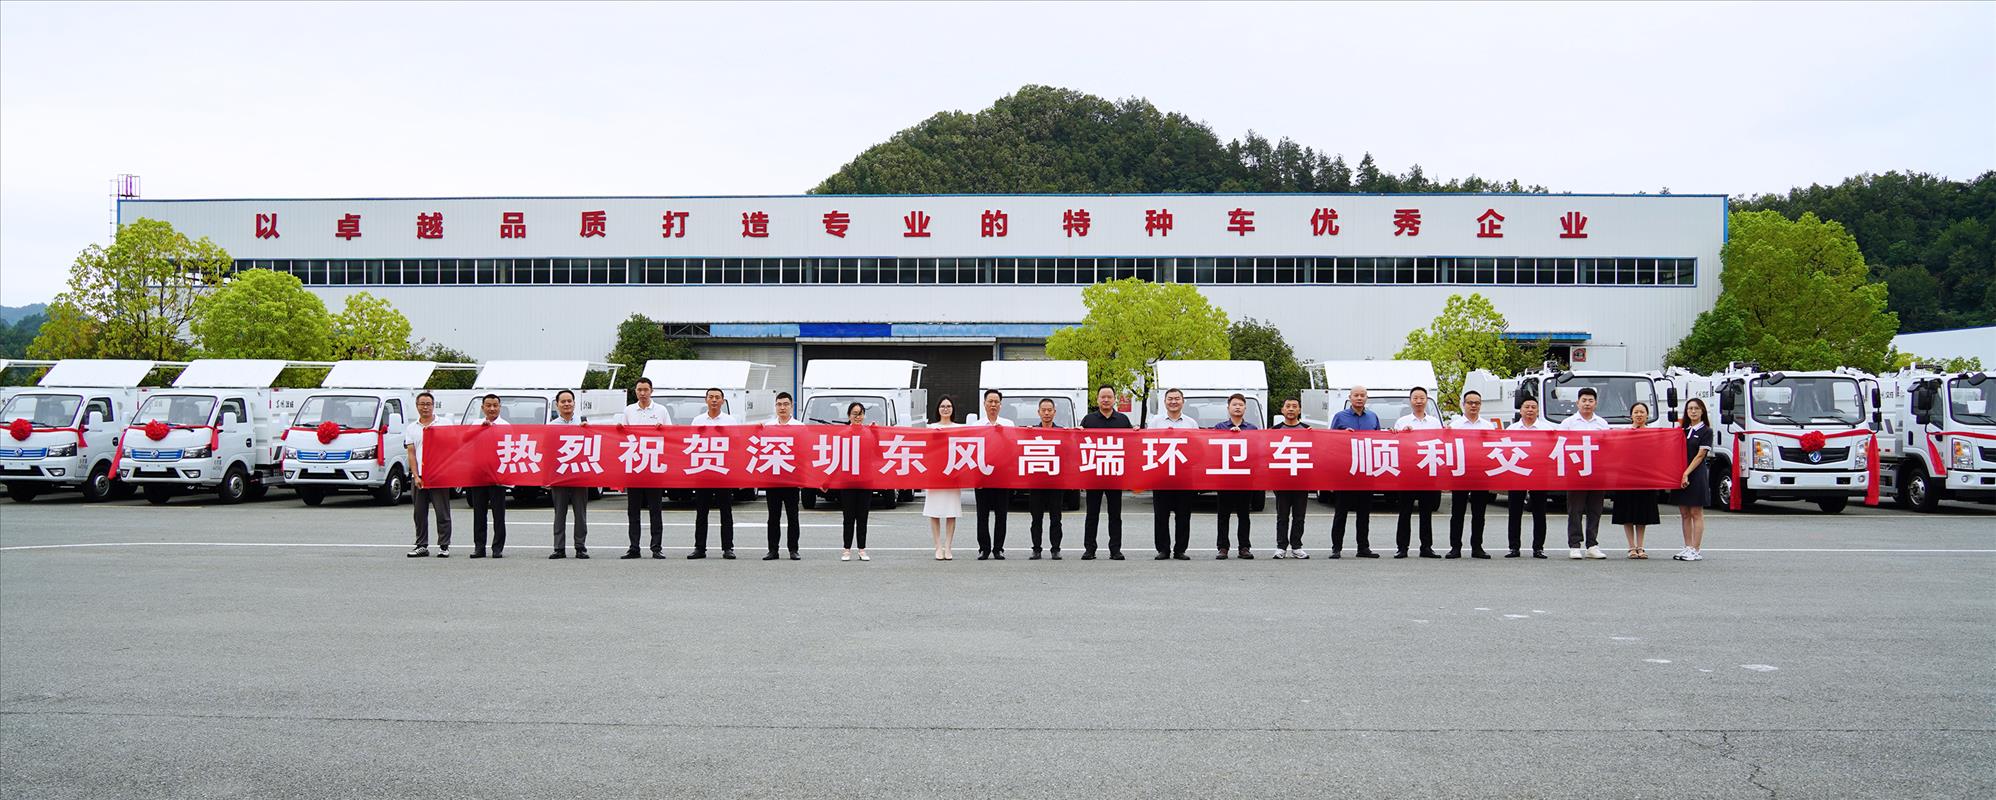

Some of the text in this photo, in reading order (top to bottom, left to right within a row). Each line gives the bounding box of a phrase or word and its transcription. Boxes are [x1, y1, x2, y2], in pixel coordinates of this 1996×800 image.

[255, 208, 1587, 239] 以卓越品质打造专业的特种车优秀企业
[496, 433, 1599, 477] 热烈祝贺深圳东风高端环卫车 顺利交付
